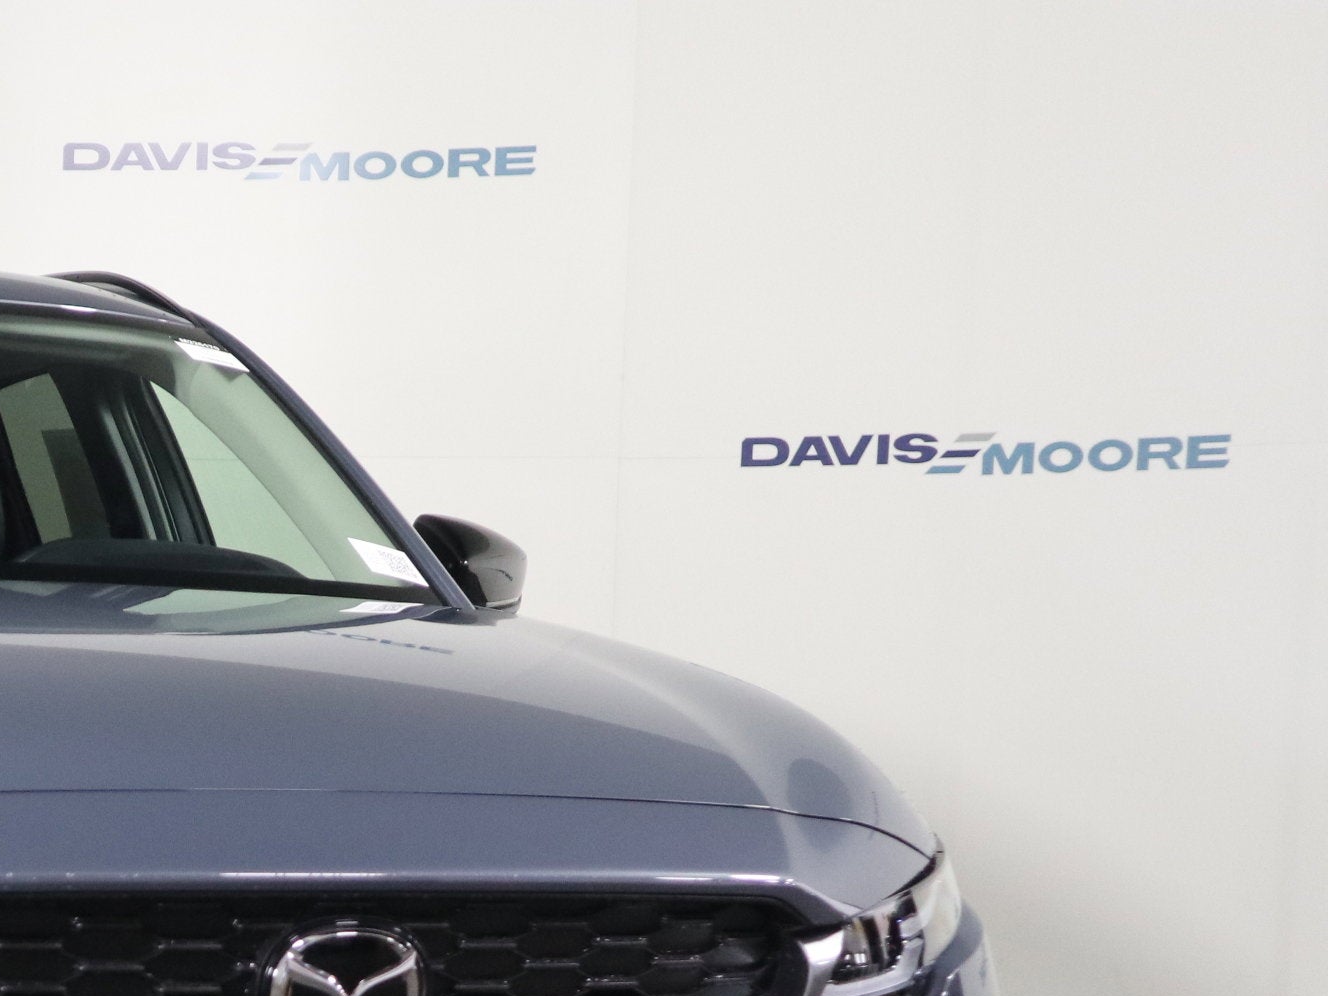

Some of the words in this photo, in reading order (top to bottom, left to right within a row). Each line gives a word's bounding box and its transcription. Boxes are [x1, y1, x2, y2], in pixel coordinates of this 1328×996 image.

[62, 141, 256, 171] DAVIS
[299, 145, 537, 181] MOORE
[740, 433, 938, 467] DAVIS
[981, 434, 1232, 475] MOORE
